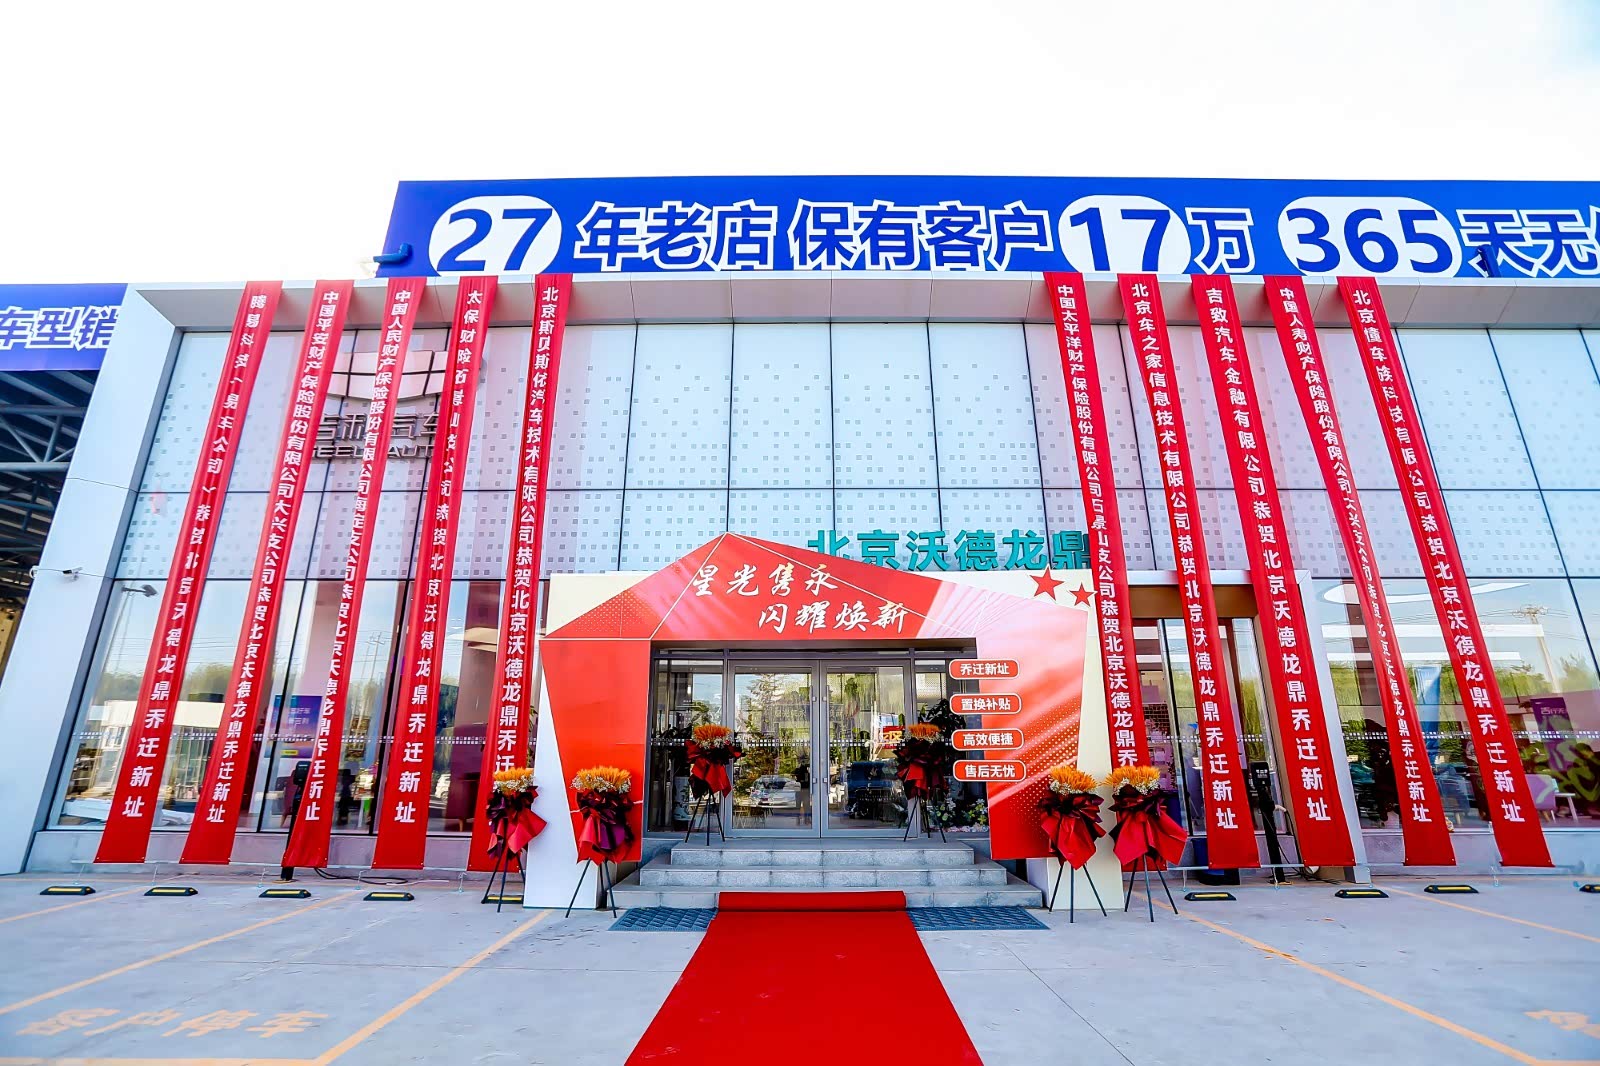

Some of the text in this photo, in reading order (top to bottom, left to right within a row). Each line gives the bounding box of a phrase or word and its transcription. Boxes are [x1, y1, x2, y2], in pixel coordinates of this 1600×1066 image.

[808, 529, 1090, 571] 北京沃德龙鼎
[1131, 283, 1238, 829] 北京车之家信息技术有限公司恭贺北京沃德龙鼎乔迁新址
[1206, 288, 1331, 821] 吉致汽车金融有限公司恭贺北京沃德龙鼎乔迁新址
[692, 562, 838, 597] 星光隽永
[758, 600, 908, 634] 闪耀焕新
[960, 663, 1010, 676] 乔迁新址
[961, 698, 1011, 711] 置换补贴
[963, 733, 1014, 746] 高效便捷
[965, 764, 1016, 778] 售后无忧
